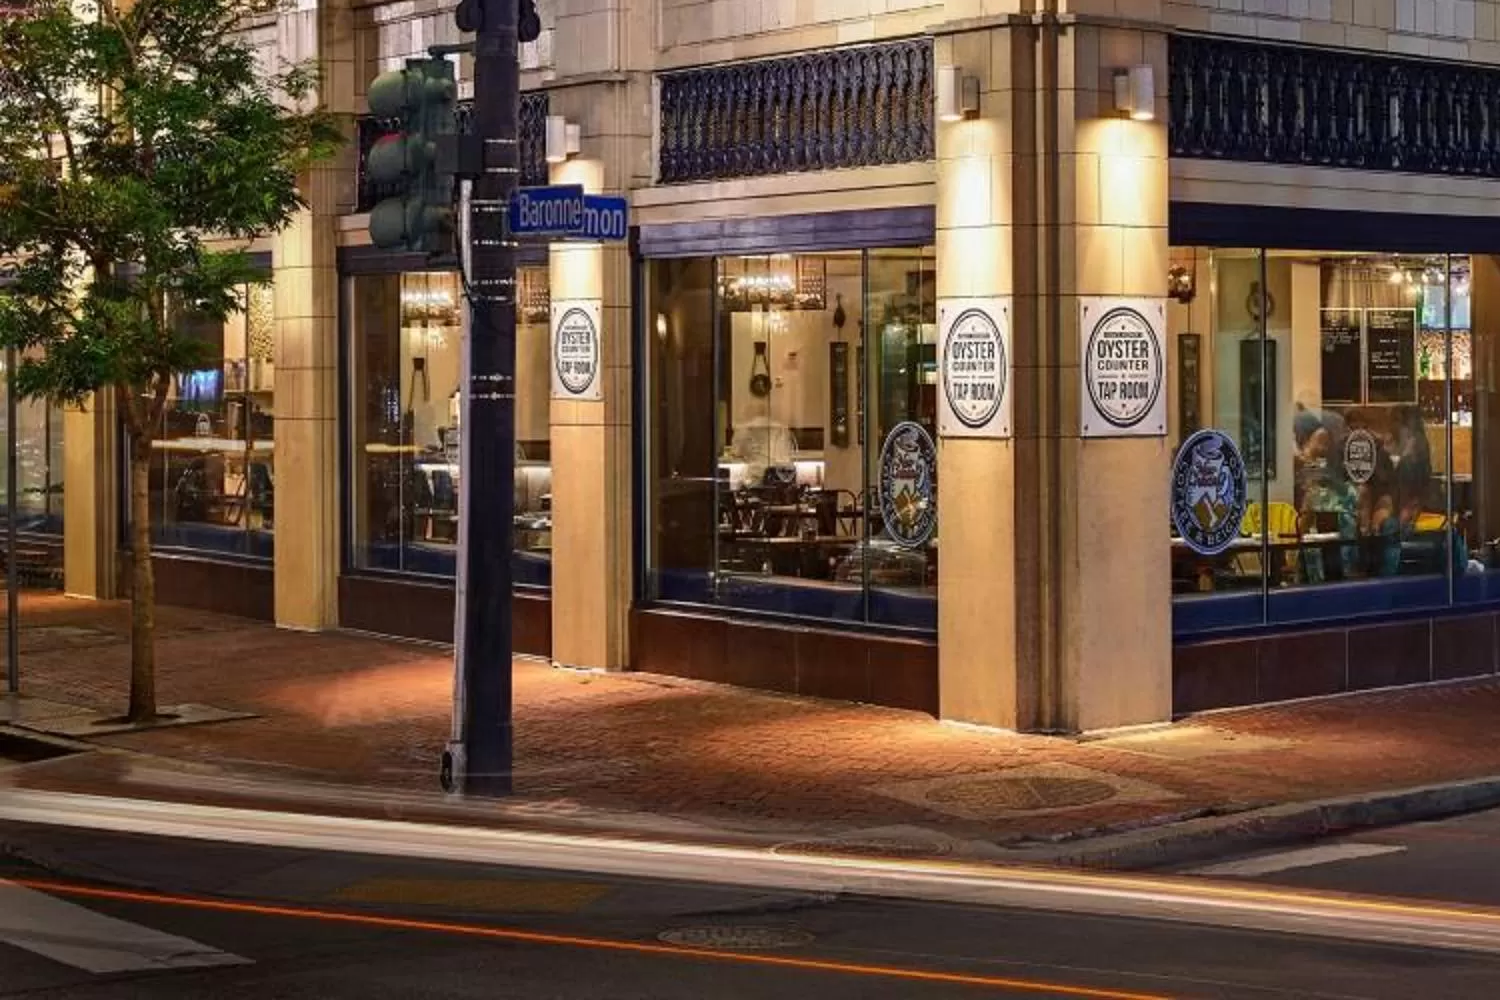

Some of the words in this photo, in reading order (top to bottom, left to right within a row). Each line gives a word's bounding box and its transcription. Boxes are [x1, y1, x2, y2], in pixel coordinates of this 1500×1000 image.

[519, 193, 581, 228] Baronne
[952, 341, 995, 359] OYSTER
[1097, 340, 1149, 358] OYSTER
[952, 362, 995, 371] COUNTER
[1097, 360, 1149, 371] COUNTER
[953, 383, 968, 400] TAP
[971, 383, 995, 400] ROOM
[1098, 381, 1117, 400] TAP
[1119, 381, 1149, 400] ROOM
